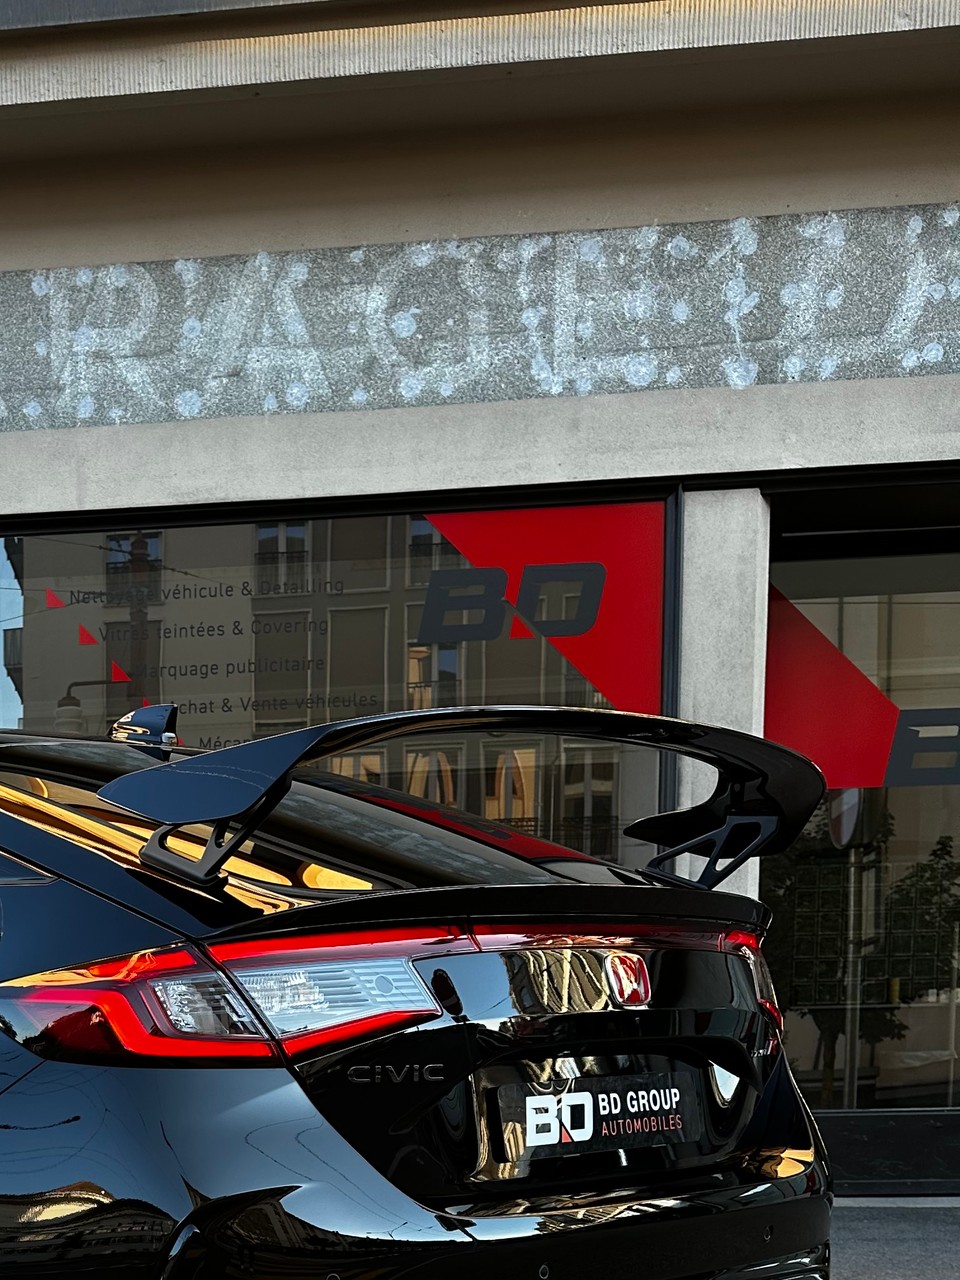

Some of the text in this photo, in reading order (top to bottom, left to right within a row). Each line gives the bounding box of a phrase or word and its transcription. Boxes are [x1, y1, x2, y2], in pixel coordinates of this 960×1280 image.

[70, 578, 344, 606] Nettoyage véhicule & Detailling
[417, 561, 607, 643] BD
[99, 618, 328, 641] Vitres teintées & Covering
[226, 658, 324, 678] publicitaire
[170, 692, 378, 715] chat & Vente véhicules
[347, 1063, 445, 1083] CIVIC
[598, 1088, 681, 1116] BD GROUP
[601, 1114, 683, 1137] AUTOMOBILES
